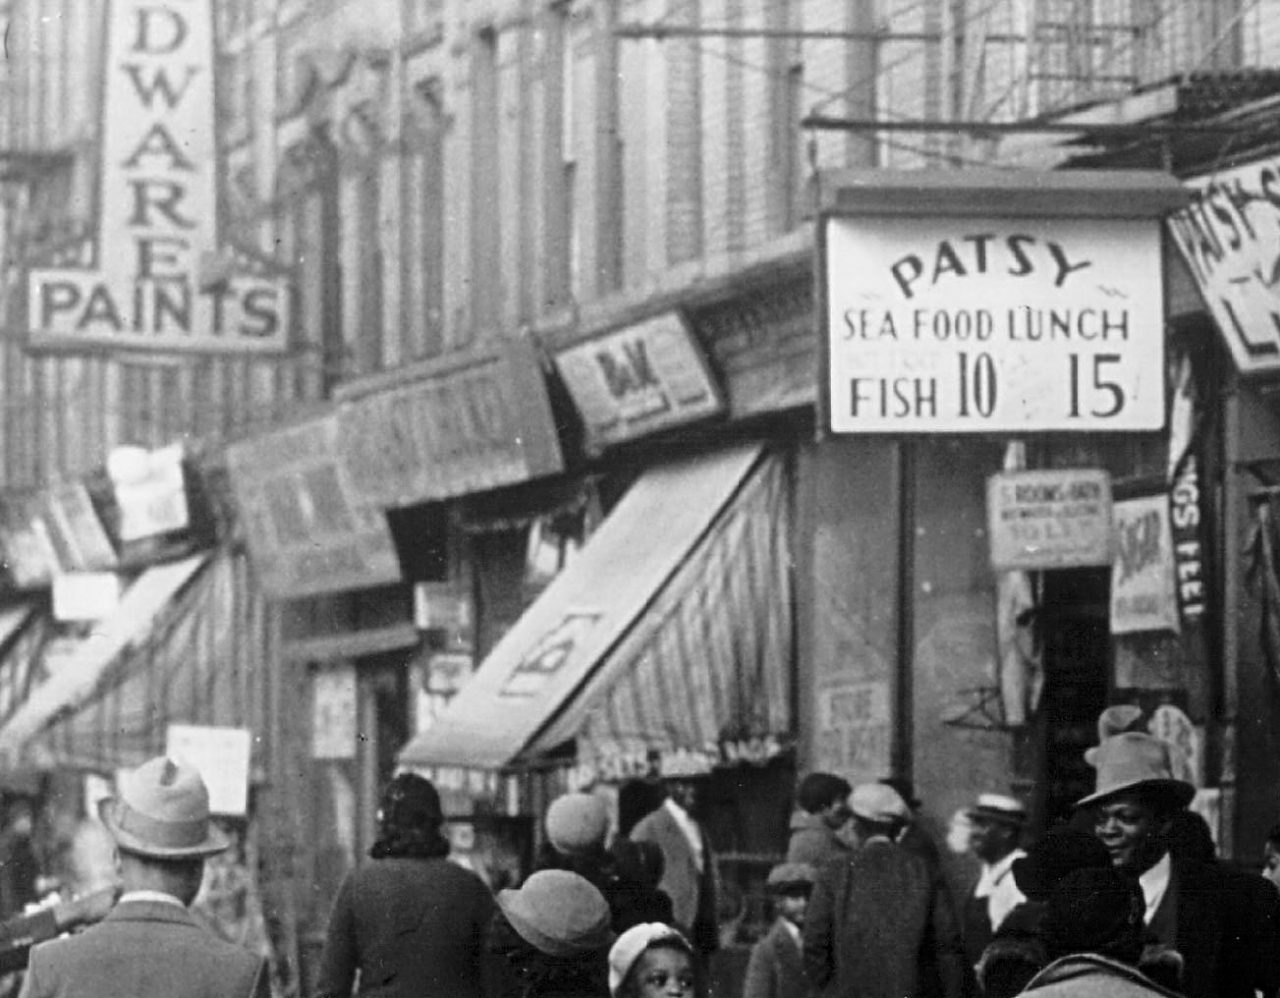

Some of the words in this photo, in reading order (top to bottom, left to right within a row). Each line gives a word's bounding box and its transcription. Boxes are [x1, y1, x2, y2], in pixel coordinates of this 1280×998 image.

[119, 8, 202, 282] DWARE
[890, 233, 1092, 298] PATSY
[40, 279, 279, 337] PAINTS
[844, 309, 897, 340] SEA
[914, 308, 992, 340] FOOD
[1008, 308, 1128, 340] LUNCH
[850, 377, 937, 418] FISH
[957, 351, 997, 419] 10
[1068, 353, 1125, 418] 15
